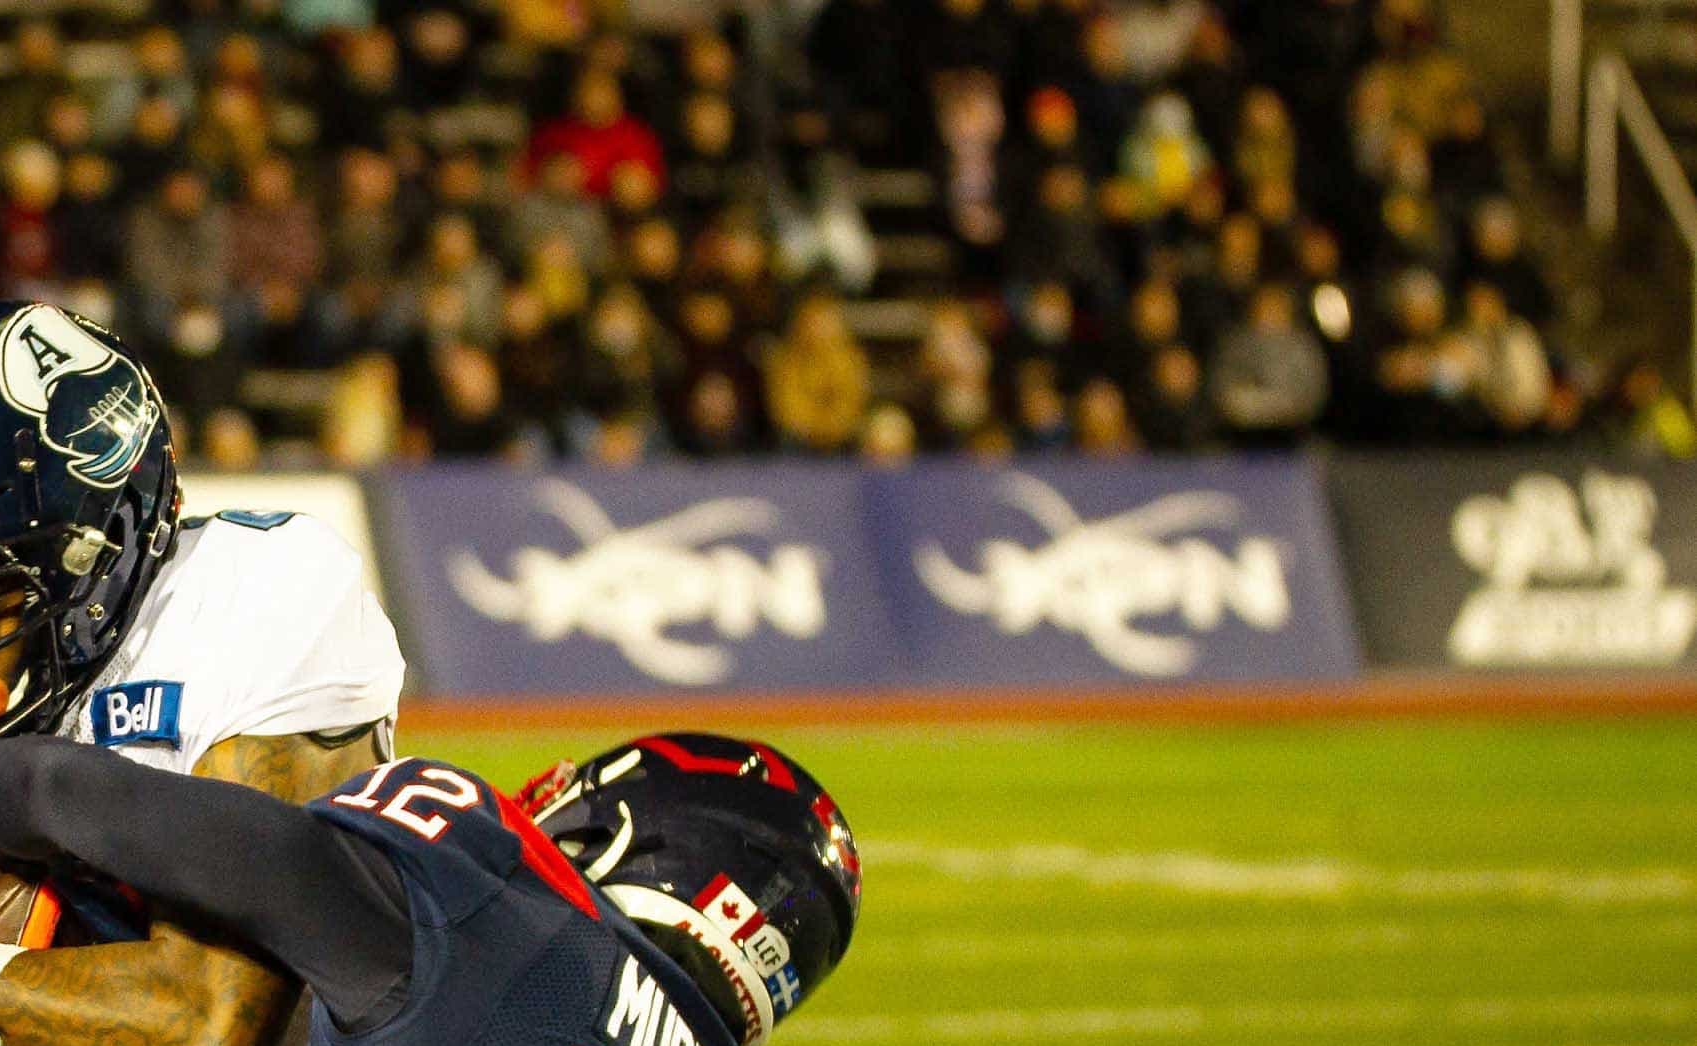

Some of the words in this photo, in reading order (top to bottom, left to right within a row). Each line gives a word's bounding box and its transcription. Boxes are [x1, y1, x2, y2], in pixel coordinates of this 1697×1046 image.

[20, 324, 73, 380] A
[106, 686, 163, 737] Bell
[332, 755, 481, 842] 12
[753, 935, 783, 967] LCF
